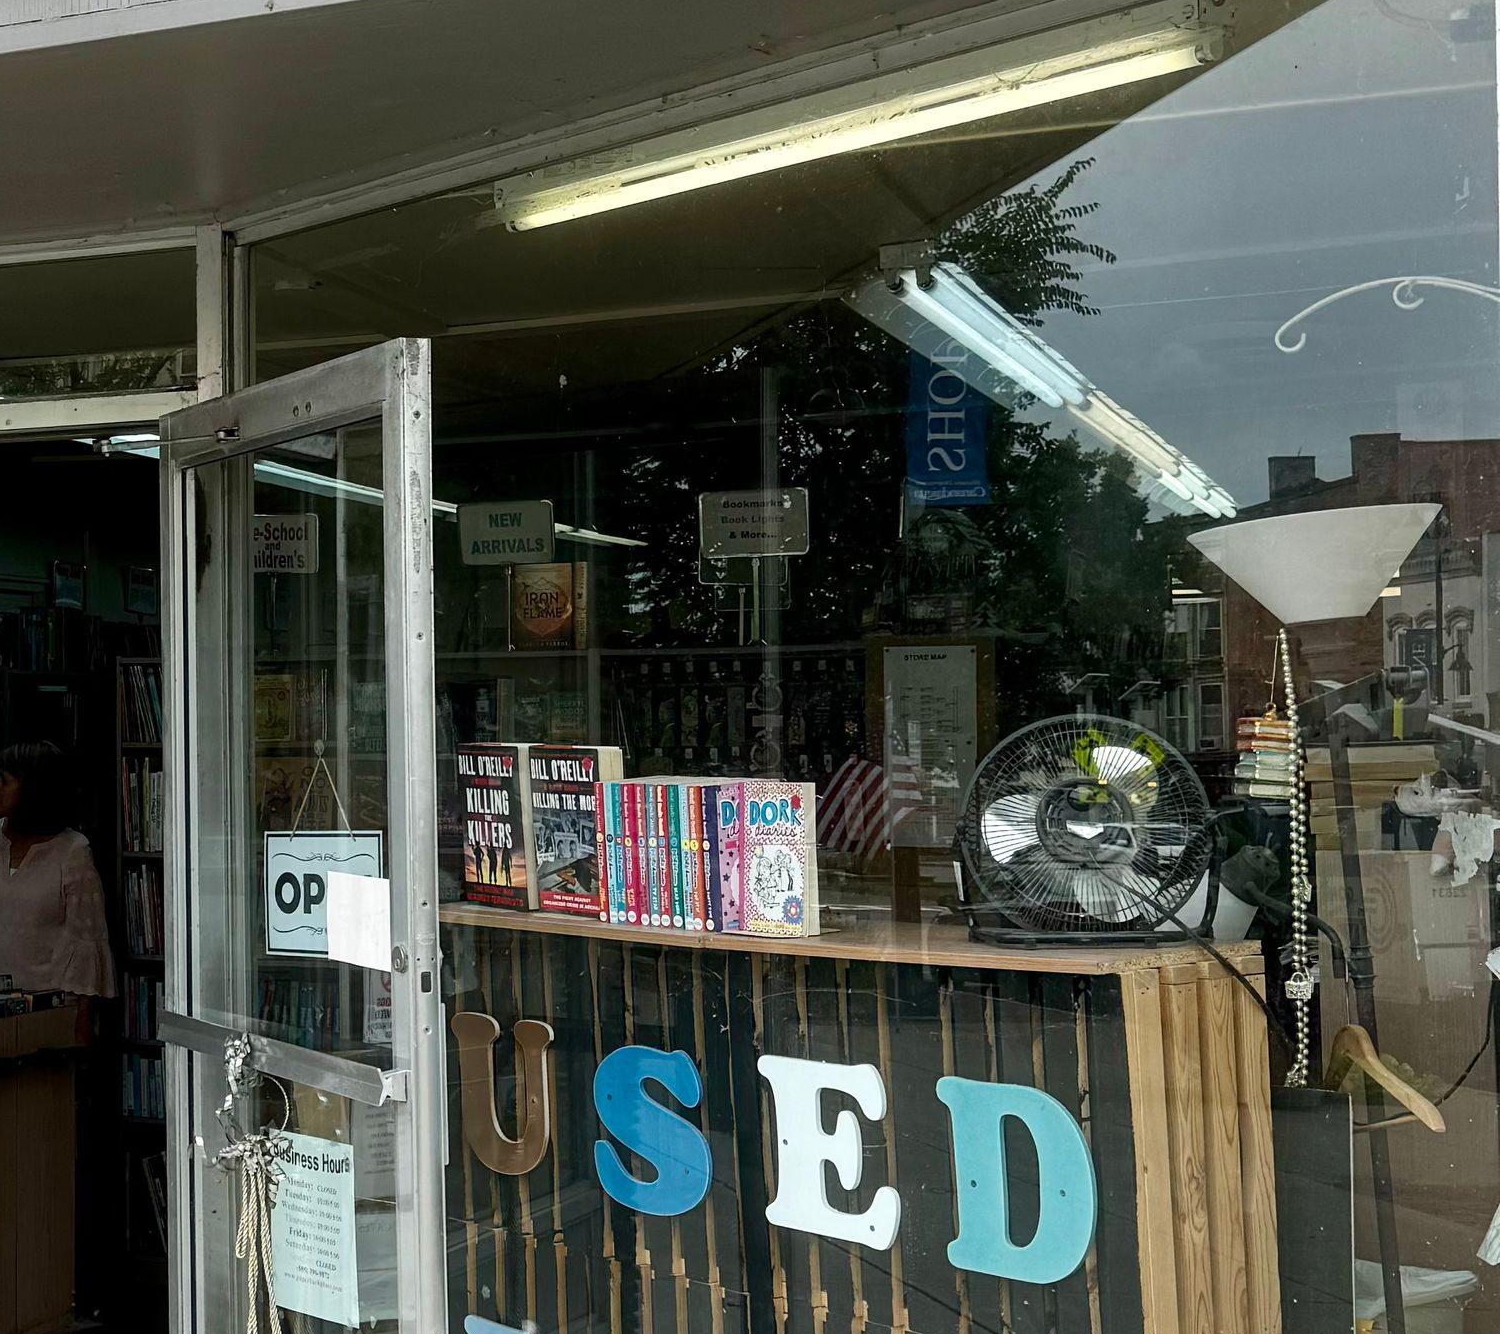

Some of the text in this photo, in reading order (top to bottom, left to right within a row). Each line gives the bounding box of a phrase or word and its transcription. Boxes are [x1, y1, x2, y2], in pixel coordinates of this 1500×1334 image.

[488, 512, 522, 529] NEW
[720, 515, 748, 524] Book
[253, 522, 309, 542] e-School
[264, 541, 281, 551] and
[471, 537, 545, 556] ARRIVALS
[525, 592, 560, 606] IRON
[523, 606, 563, 619] FLAME
[458, 754, 514, 778] BILL O'REILLY
[530, 758, 595, 783] BILL O'REILLY
[465, 788, 510, 816] KILLING
[532, 792, 560, 810] KILLING
[561, 793, 578, 811] THE
[749, 798, 802, 827] DORK
[467, 820, 513, 849] KILLERS
[754, 825, 798, 839] diaries
[275, 872, 327, 914] OP
[450, 1011, 1097, 1284] USED
